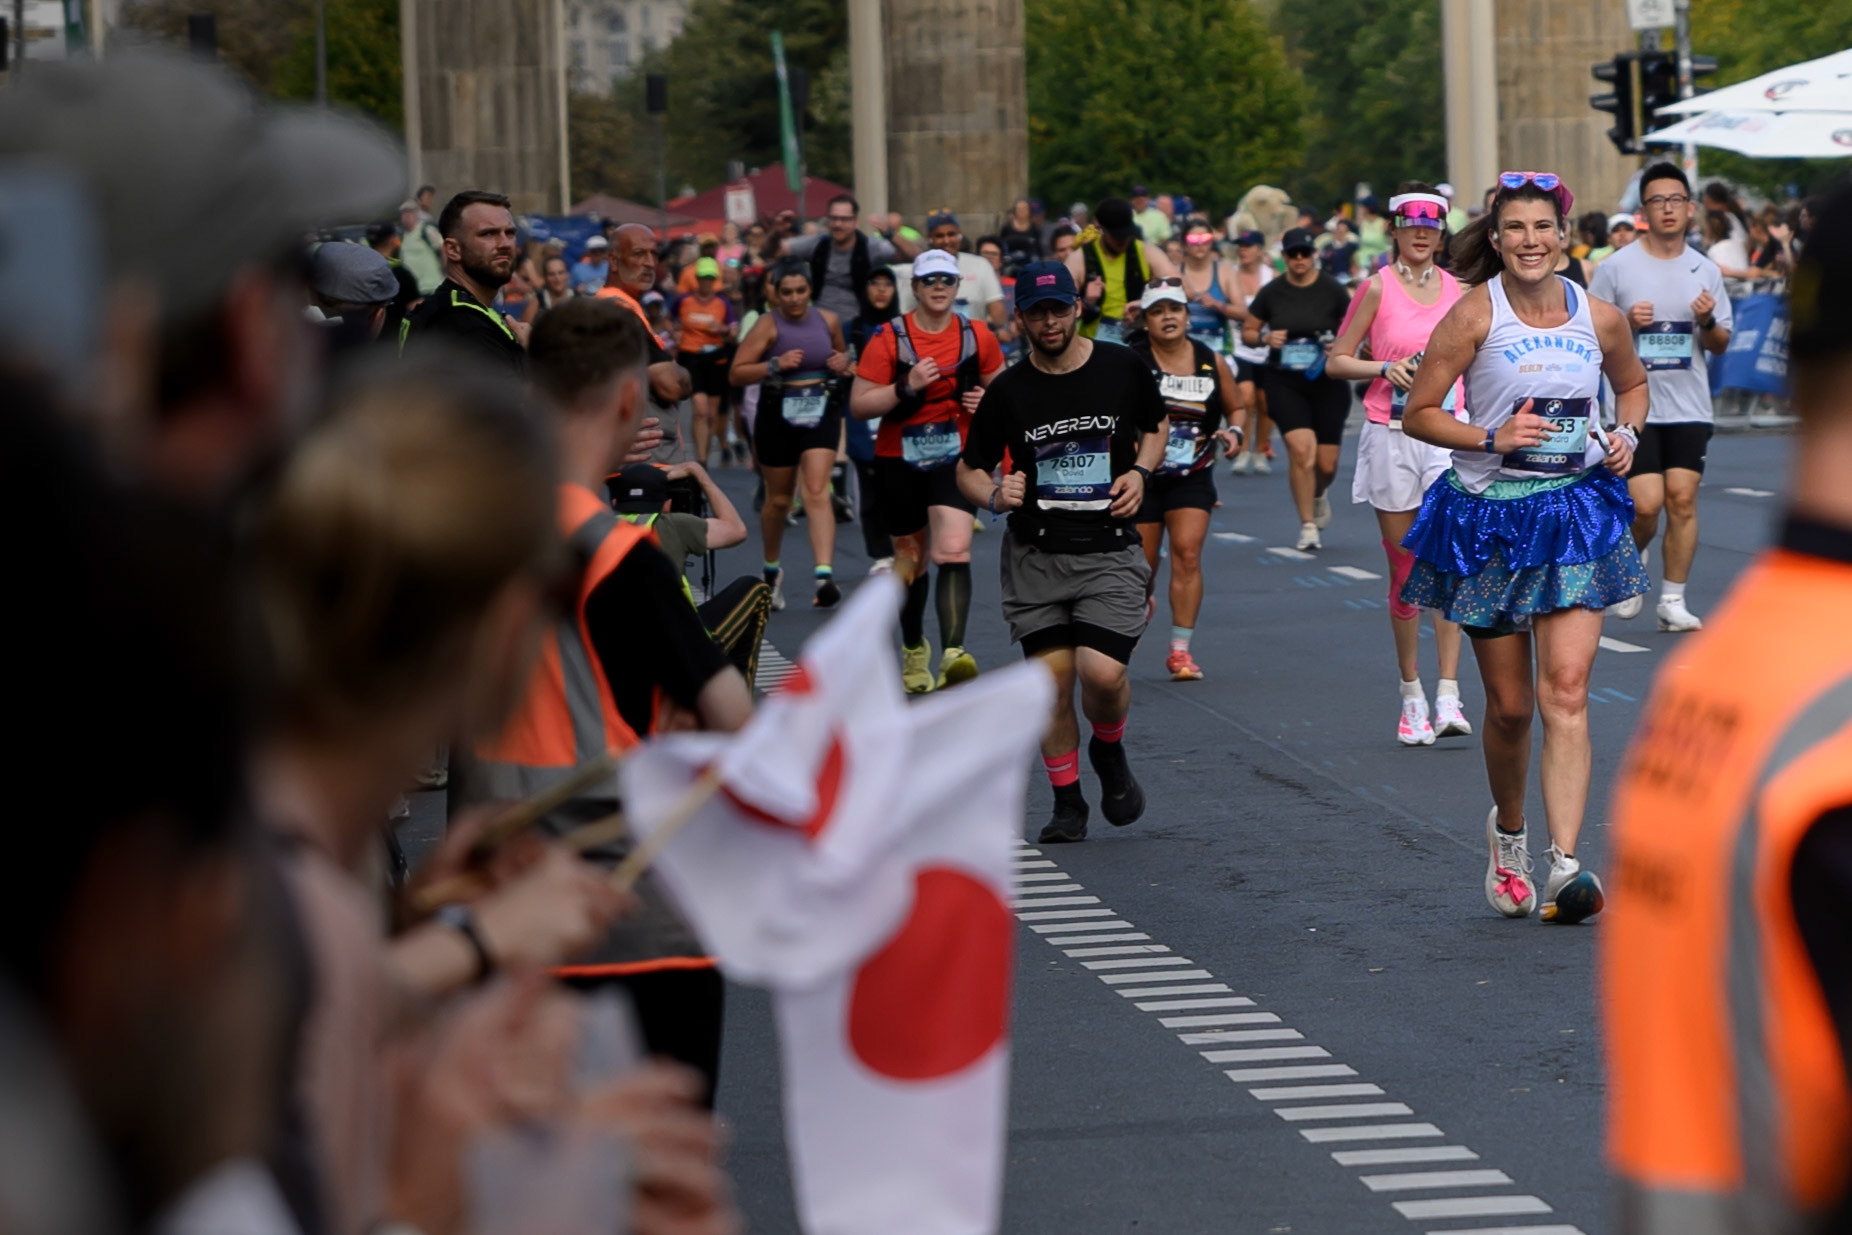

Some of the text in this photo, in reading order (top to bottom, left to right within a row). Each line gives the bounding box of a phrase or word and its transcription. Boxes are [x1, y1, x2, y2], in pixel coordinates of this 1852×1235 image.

[1503, 336, 1592, 364] ALEXANDRA
[1051, 455, 1095, 469] 76107
[1525, 454, 1567, 464] zalando
[1063, 468, 1084, 476] David
[1055, 486, 1093, 494] zalando
